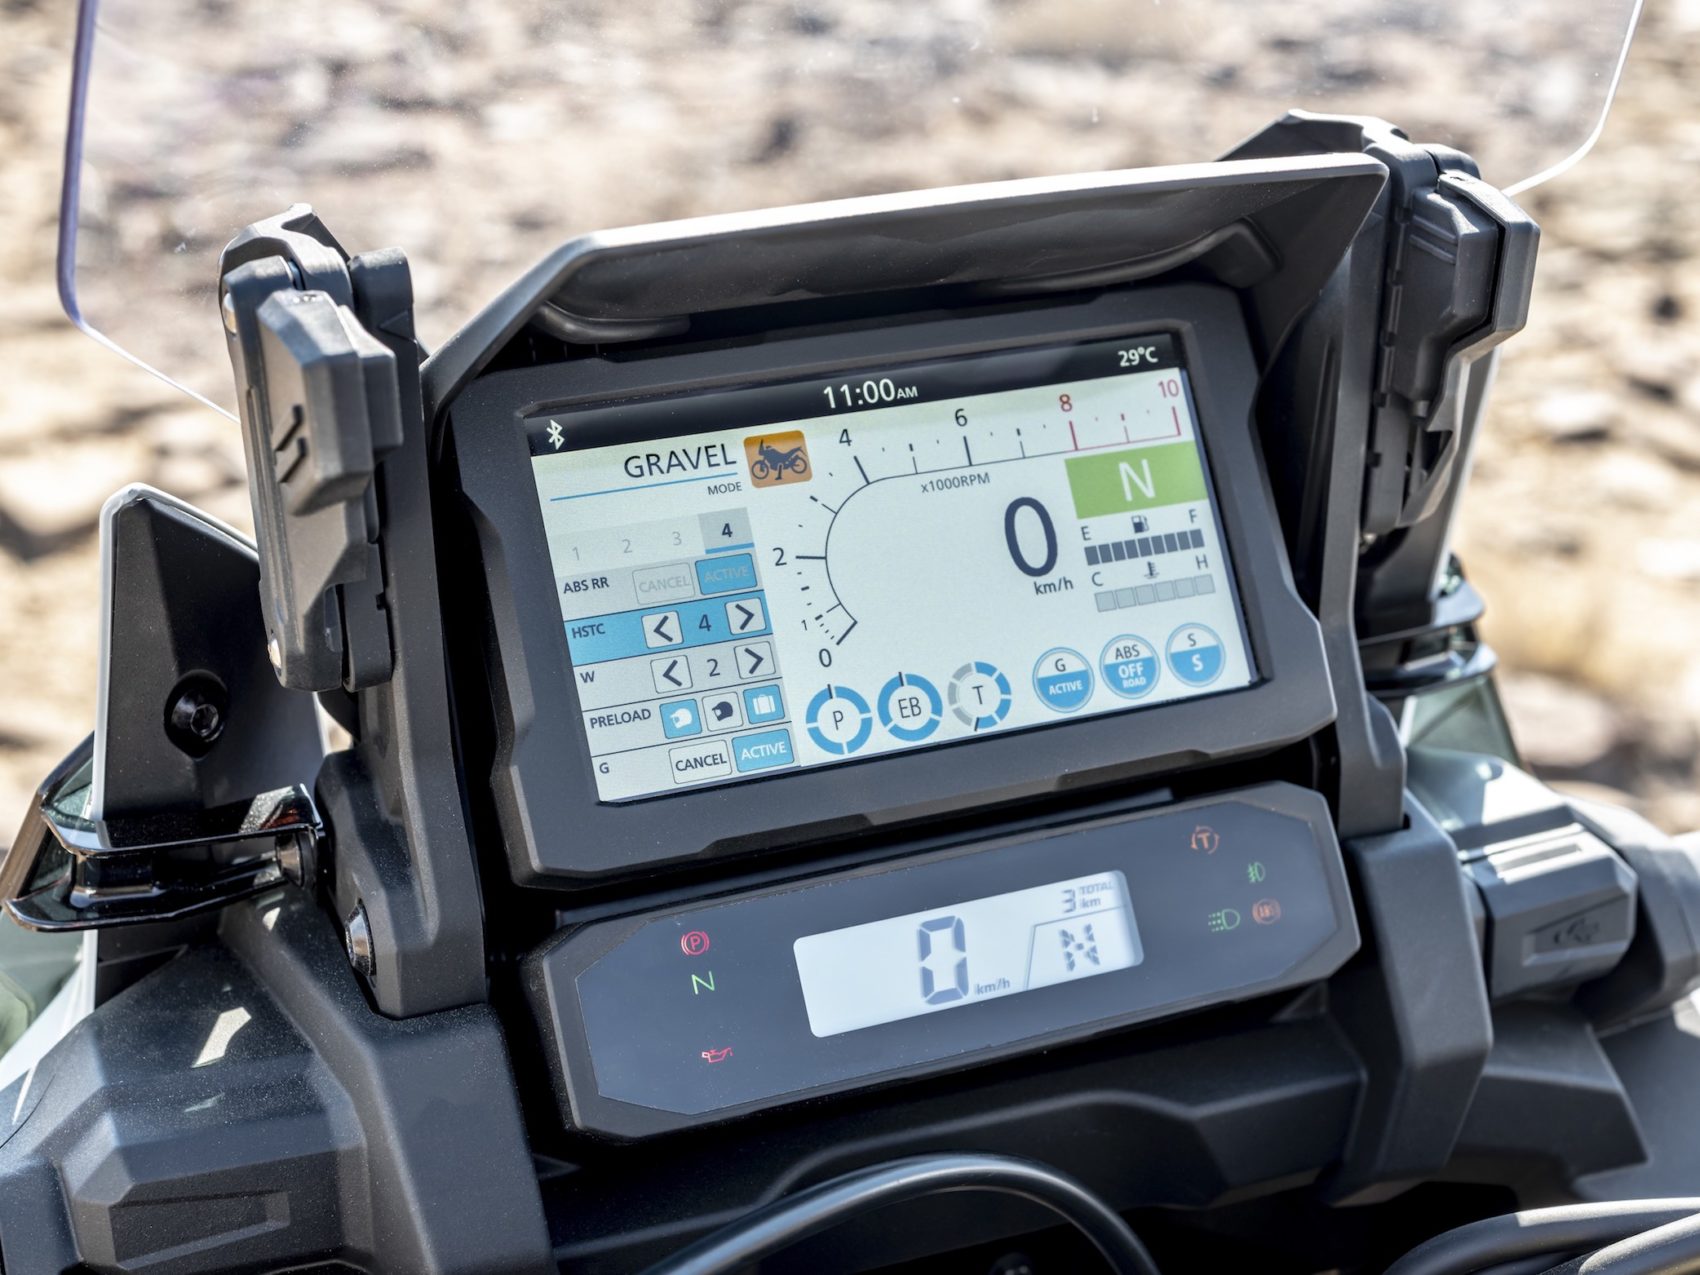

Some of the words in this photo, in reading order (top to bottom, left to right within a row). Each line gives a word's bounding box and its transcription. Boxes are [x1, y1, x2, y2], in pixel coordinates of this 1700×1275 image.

[1118, 346, 1158, 367] 29°C
[1158, 379, 1180, 399] 10
[1059, 393, 1073, 412] 8
[954, 408, 968, 427] 6
[838, 428, 852, 447] 4
[624, 443, 737, 479] GRAVEL
[707, 481, 743, 496] MODE
[921, 472, 991, 493] x1000RPM
[1119, 459, 1156, 502] N
[1189, 509, 1198, 524] F
[672, 531, 683, 546] 3
[721, 523, 733, 538] 4
[1004, 496, 1059, 577] 0
[1081, 526, 1092, 541] E
[622, 539, 633, 554] 2
[772, 547, 788, 567] 2
[1196, 555, 1209, 570] H
[703, 565, 751, 583] ACTIVE
[1092, 572, 1104, 586] C
[563, 579, 589, 594] ABS
[592, 576, 610, 590] RR
[638, 575, 692, 593] CANCEL
[1034, 578, 1075, 596] km/h
[571, 623, 606, 639] HSTC
[698, 614, 712, 632] 4
[801, 619, 808, 631] 1
[1187, 633, 1197, 647] S
[819, 648, 833, 668] 0
[1115, 644, 1141, 661] ABS
[706, 658, 721, 677] 2
[1055, 658, 1066, 673] G
[1118, 662, 1145, 678] OFF
[1192, 654, 1204, 672] S
[580, 670, 595, 683] W
[1122, 676, 1147, 689] ROAD
[972, 685, 984, 705] T
[1049, 679, 1083, 696] ACTIVE
[898, 696, 922, 719] EB
[589, 708, 651, 729] PRELOAD
[833, 710, 844, 730] P
[741, 741, 787, 760] ACTIVE
[599, 762, 610, 774] G
[675, 752, 728, 772] CANCEL
[1080, 882, 1114, 896] TOTAL
[1062, 889, 1076, 913] 3
[1083, 896, 1101, 909] km
[918, 915, 968, 1005] 0
[691, 971, 715, 995] N
[975, 978, 1011, 995] km/h
